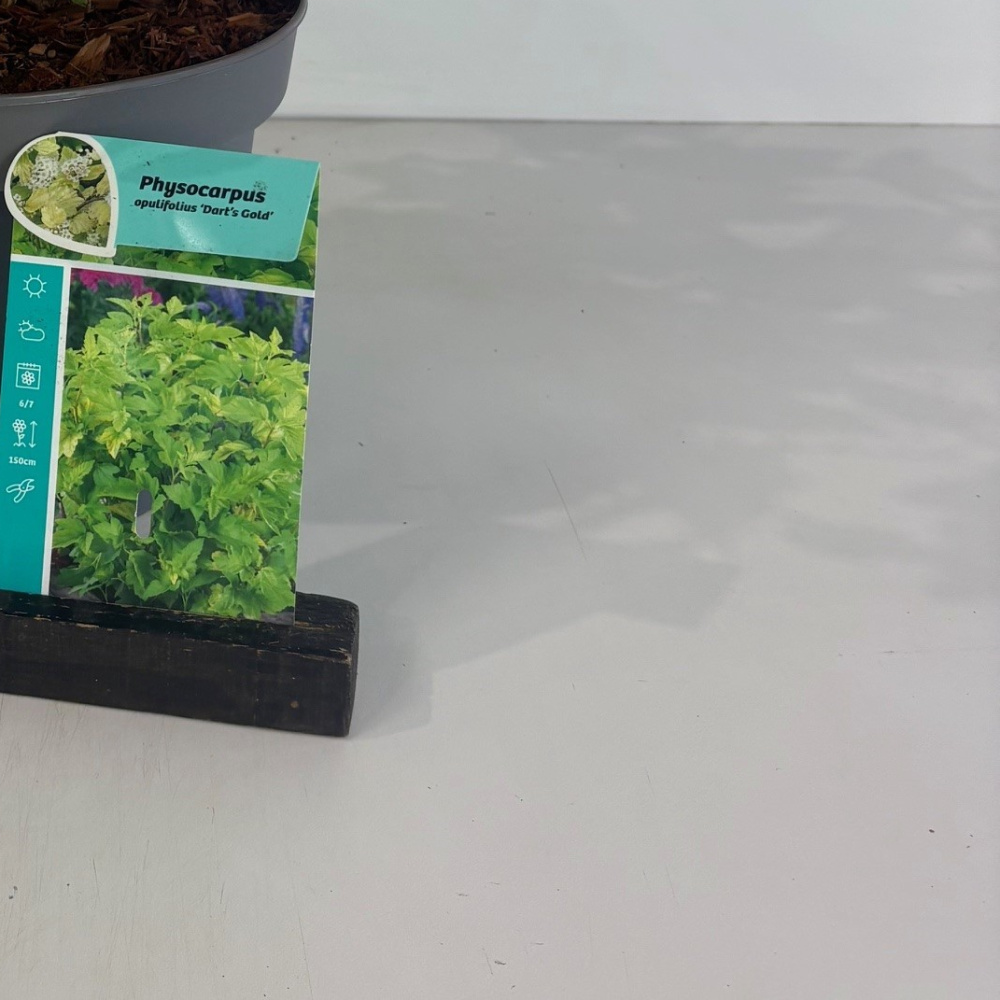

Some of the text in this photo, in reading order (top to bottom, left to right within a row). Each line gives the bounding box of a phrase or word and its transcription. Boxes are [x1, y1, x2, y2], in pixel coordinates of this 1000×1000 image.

[139, 175, 267, 204] Physocarpus
[134, 198, 198, 213] opulifolius
[18, 399, 34, 408] 6/7
[8, 456, 36, 466] 150cm
